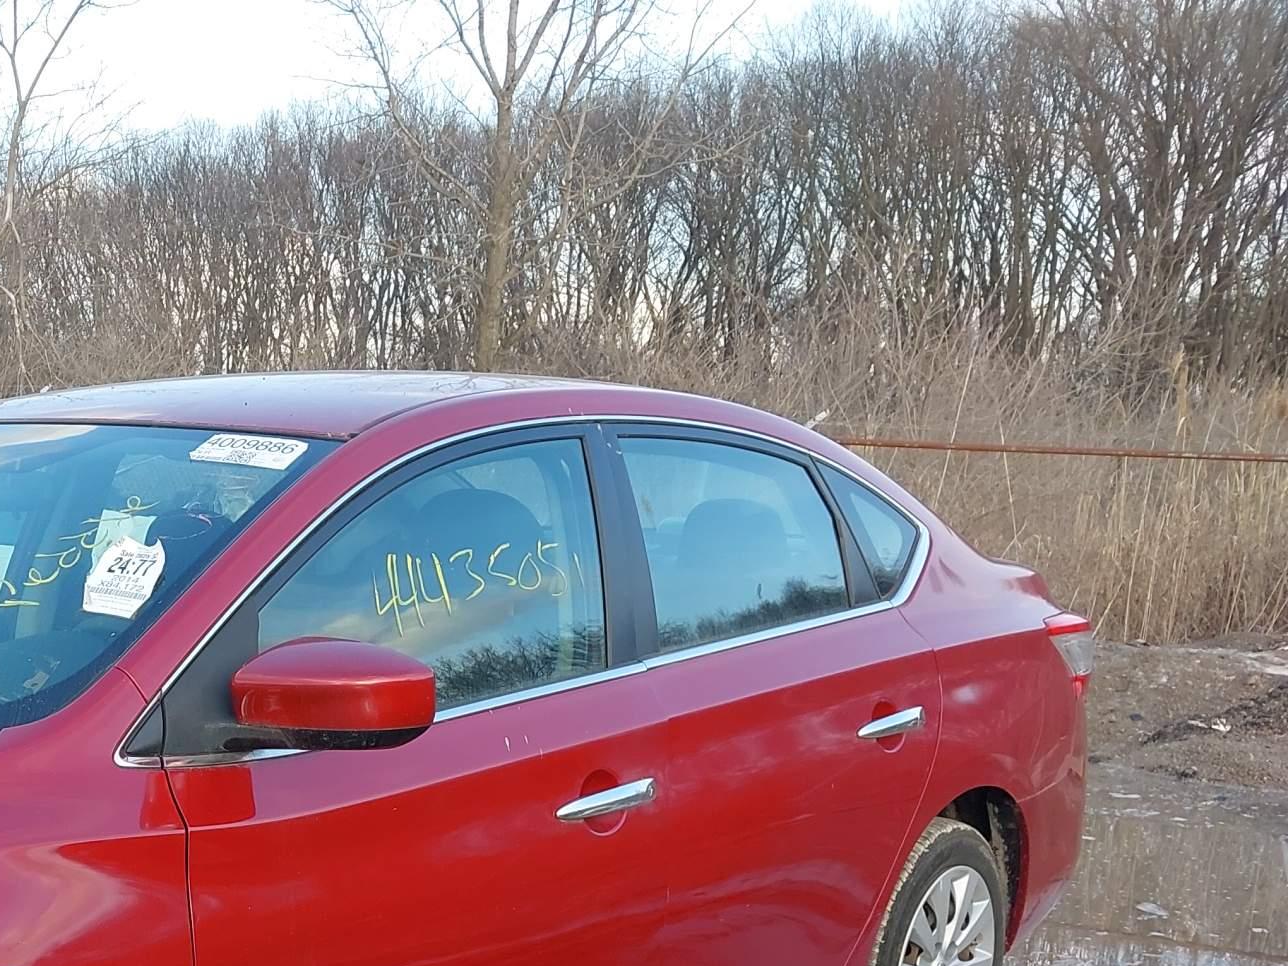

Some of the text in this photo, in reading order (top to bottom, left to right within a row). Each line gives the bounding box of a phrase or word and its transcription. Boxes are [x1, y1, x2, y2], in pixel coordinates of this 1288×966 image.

[207, 437, 300, 455] 4009886
[107, 557, 157, 576] 24:77
[372, 538, 586, 640] 44435051
